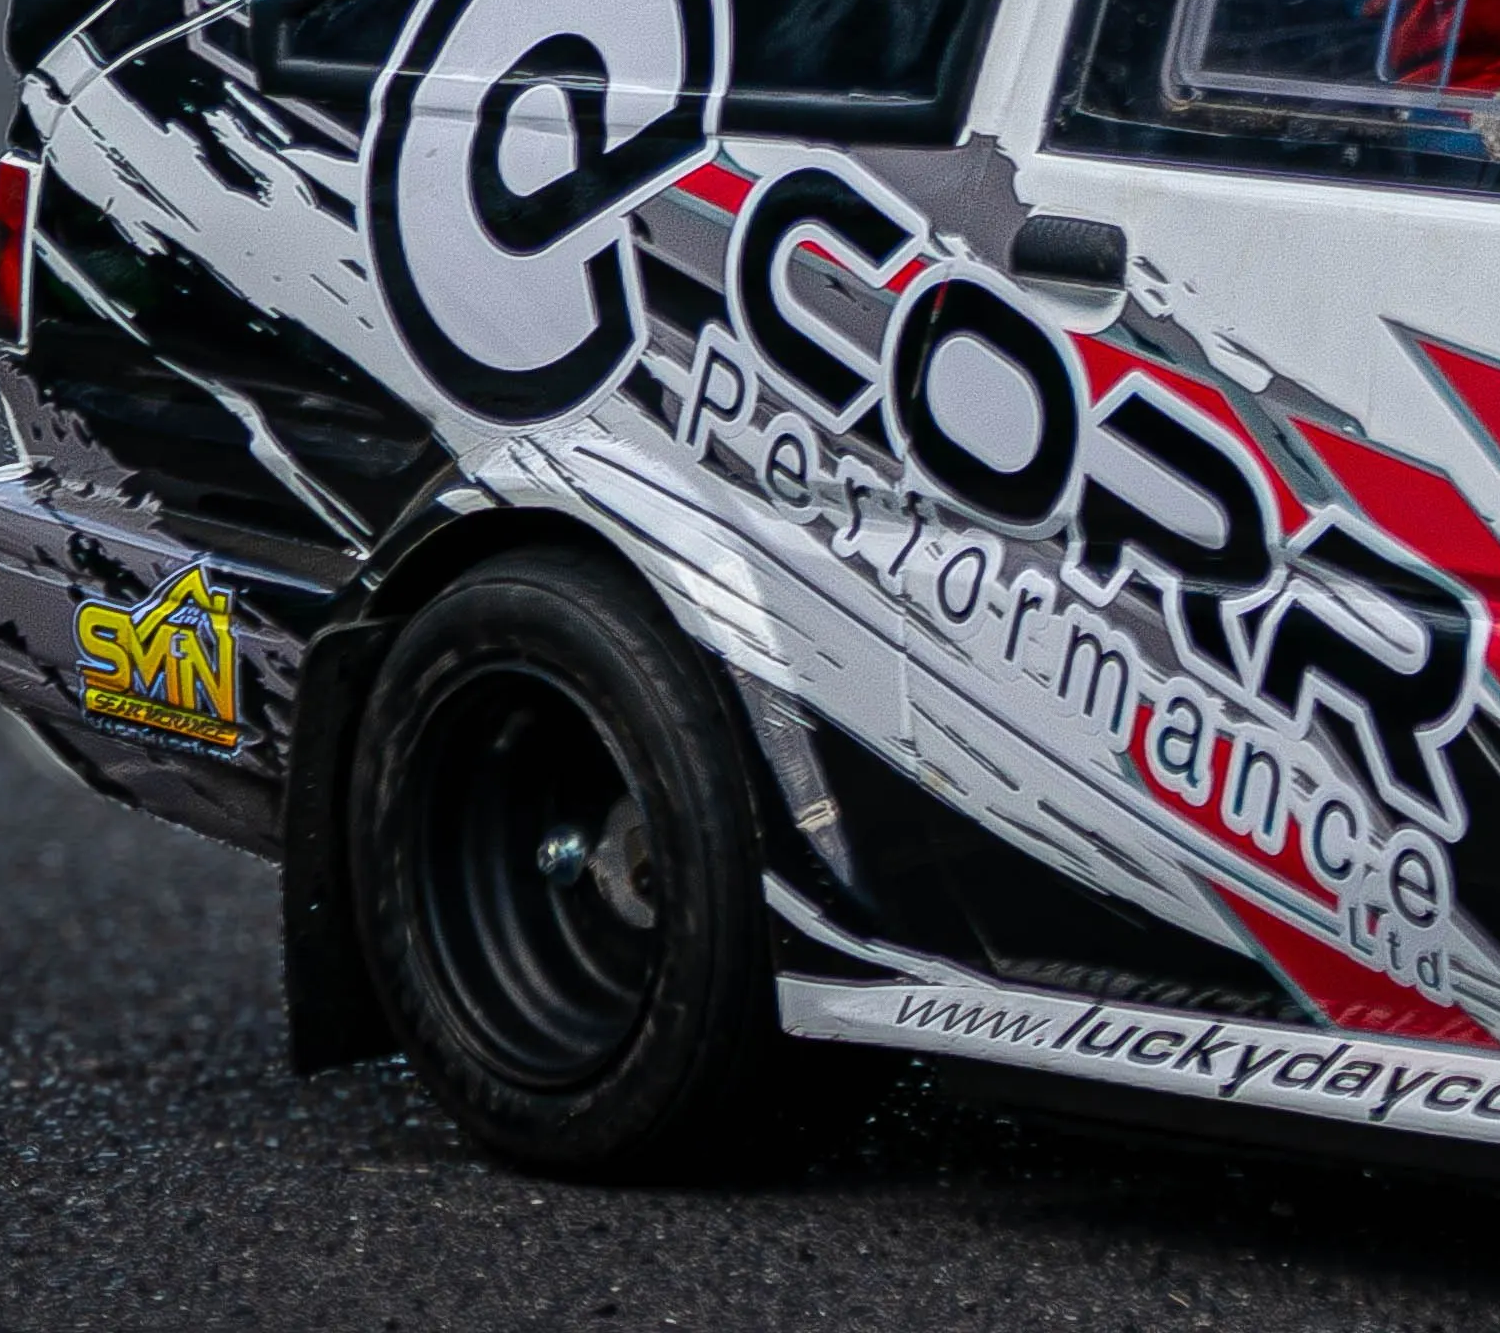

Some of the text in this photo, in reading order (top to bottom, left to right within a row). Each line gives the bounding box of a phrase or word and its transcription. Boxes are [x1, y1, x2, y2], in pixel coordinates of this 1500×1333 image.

[77, 568, 236, 727] SMN
[684, 339, 1443, 931] Performance
[1350, 903, 1443, 992] Ltd
